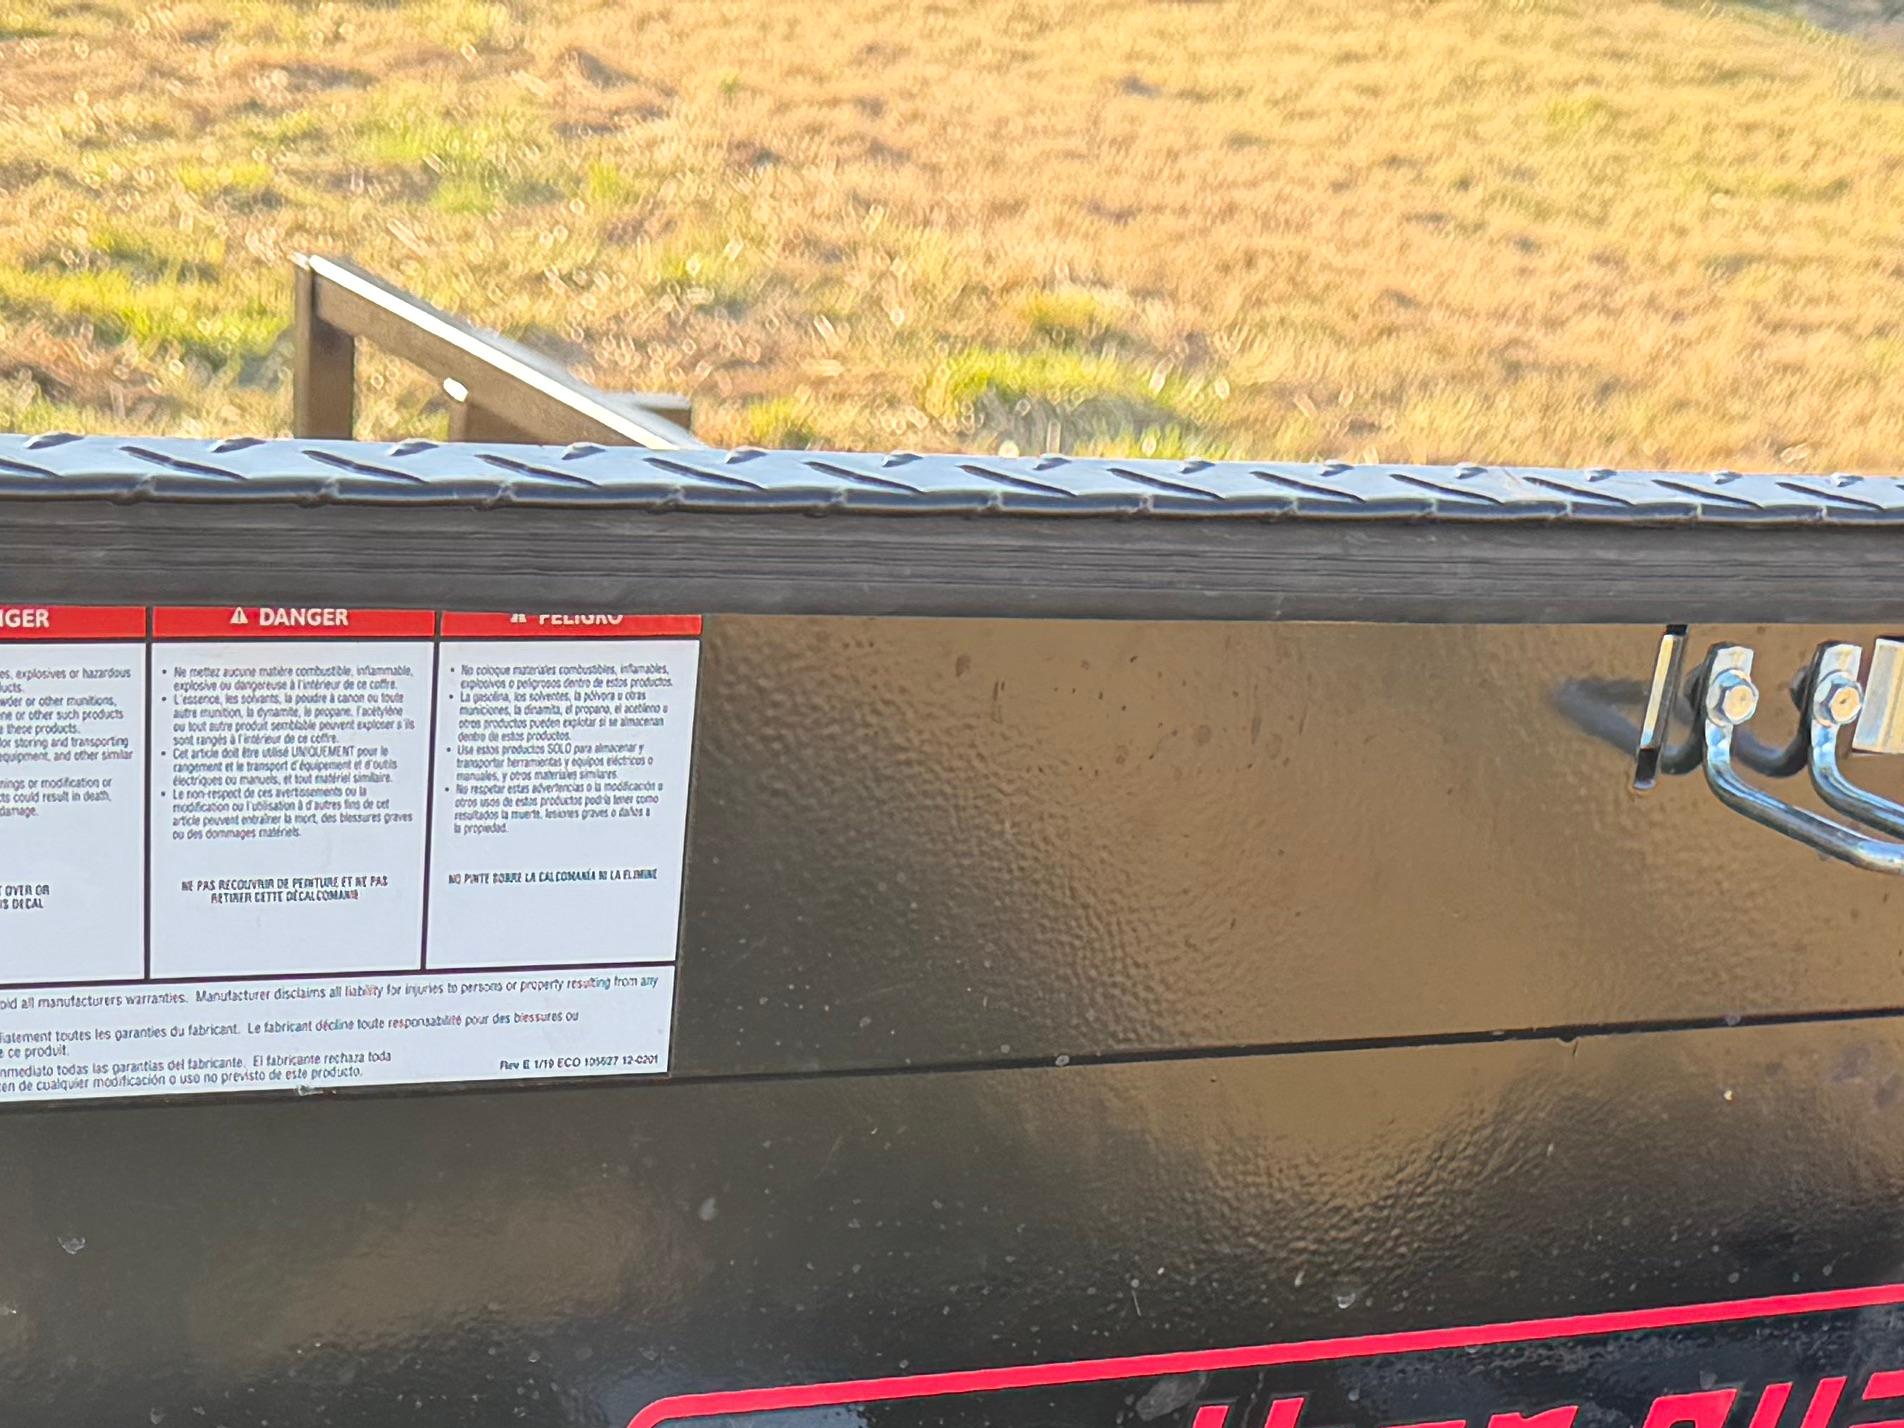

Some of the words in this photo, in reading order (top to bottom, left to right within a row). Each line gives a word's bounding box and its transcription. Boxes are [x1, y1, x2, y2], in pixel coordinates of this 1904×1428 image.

[259, 607, 349, 627] DANGER
[16, 670, 67, 682] explosives
[82, 668, 131, 679] hazardous
[5, 885, 32, 896] OVER
[12, 898, 44, 910] DECAL
[22, 997, 34, 1009] all
[196, 990, 270, 1002] Manufacturer
[273, 986, 327, 1001] disclaims
[329, 984, 342, 998] all
[448, 983, 458, 995] to
[461, 983, 502, 996] persons
[505, 982, 518, 993] or
[520, 979, 564, 992] property
[567, 978, 610, 990] resulting
[613, 976, 637, 988] from
